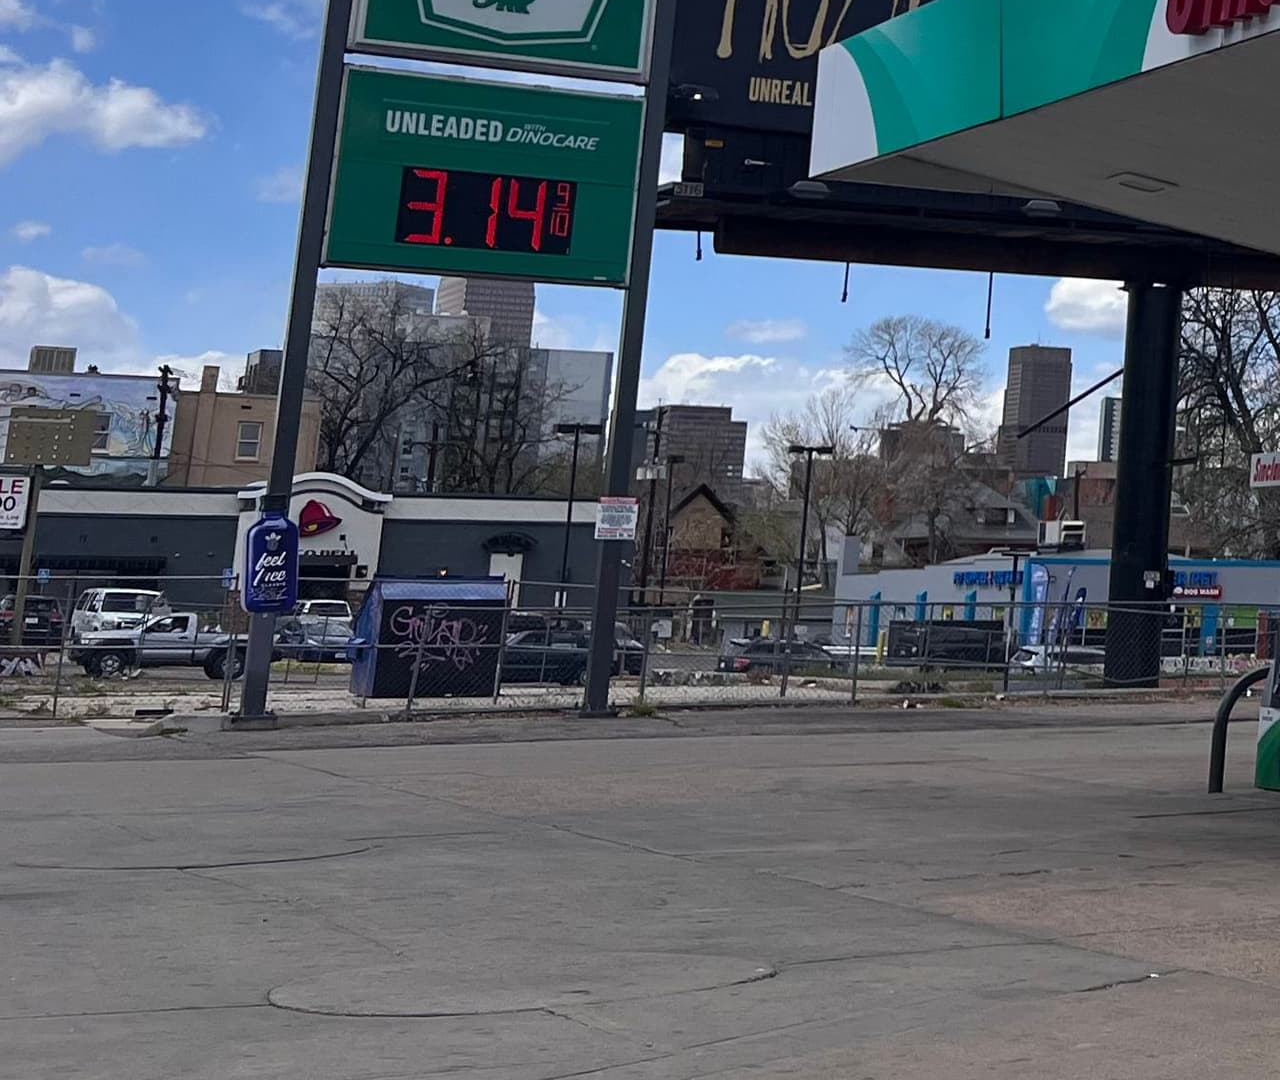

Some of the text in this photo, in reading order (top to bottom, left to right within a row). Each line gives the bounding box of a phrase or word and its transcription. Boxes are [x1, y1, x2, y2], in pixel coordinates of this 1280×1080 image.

[750, 77, 812, 106] UNREAL
[386, 109, 600, 150] UNLEADED WITH DINOCARE
[404, 169, 547, 251] 3.14
